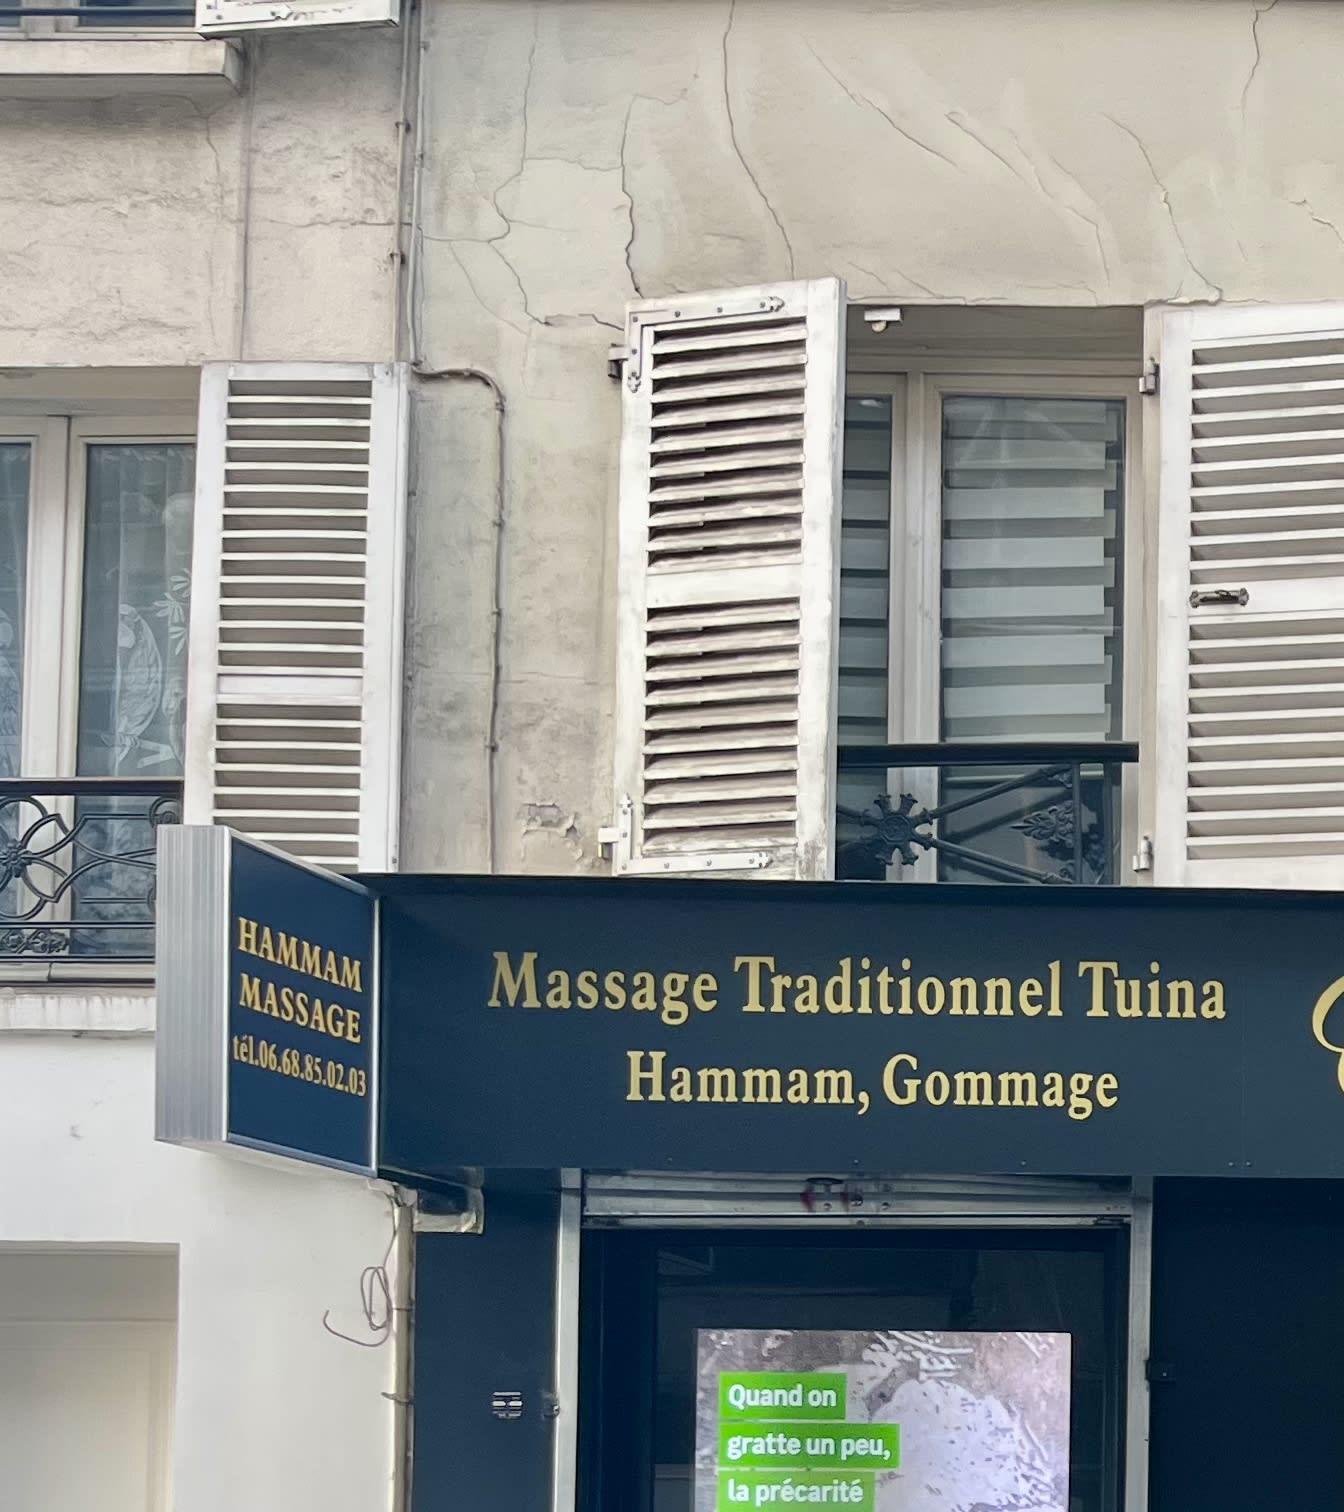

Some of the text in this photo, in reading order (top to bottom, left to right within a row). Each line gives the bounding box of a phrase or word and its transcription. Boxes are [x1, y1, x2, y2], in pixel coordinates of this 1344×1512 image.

[238, 915, 362, 994] HAMMAM
[239, 978, 362, 1046] MASSAGE
[487, 952, 1227, 1026] Massage Traditionnel Tuina
[232, 1031, 367, 1098] tél.06.68.85.02.03
[626, 1050, 1119, 1121] Hammam, Gommage
[728, 1383, 838, 1408] Quand on
[727, 1433, 891, 1460] gratte un peu,
[728, 1478, 864, 1507] la précarité
